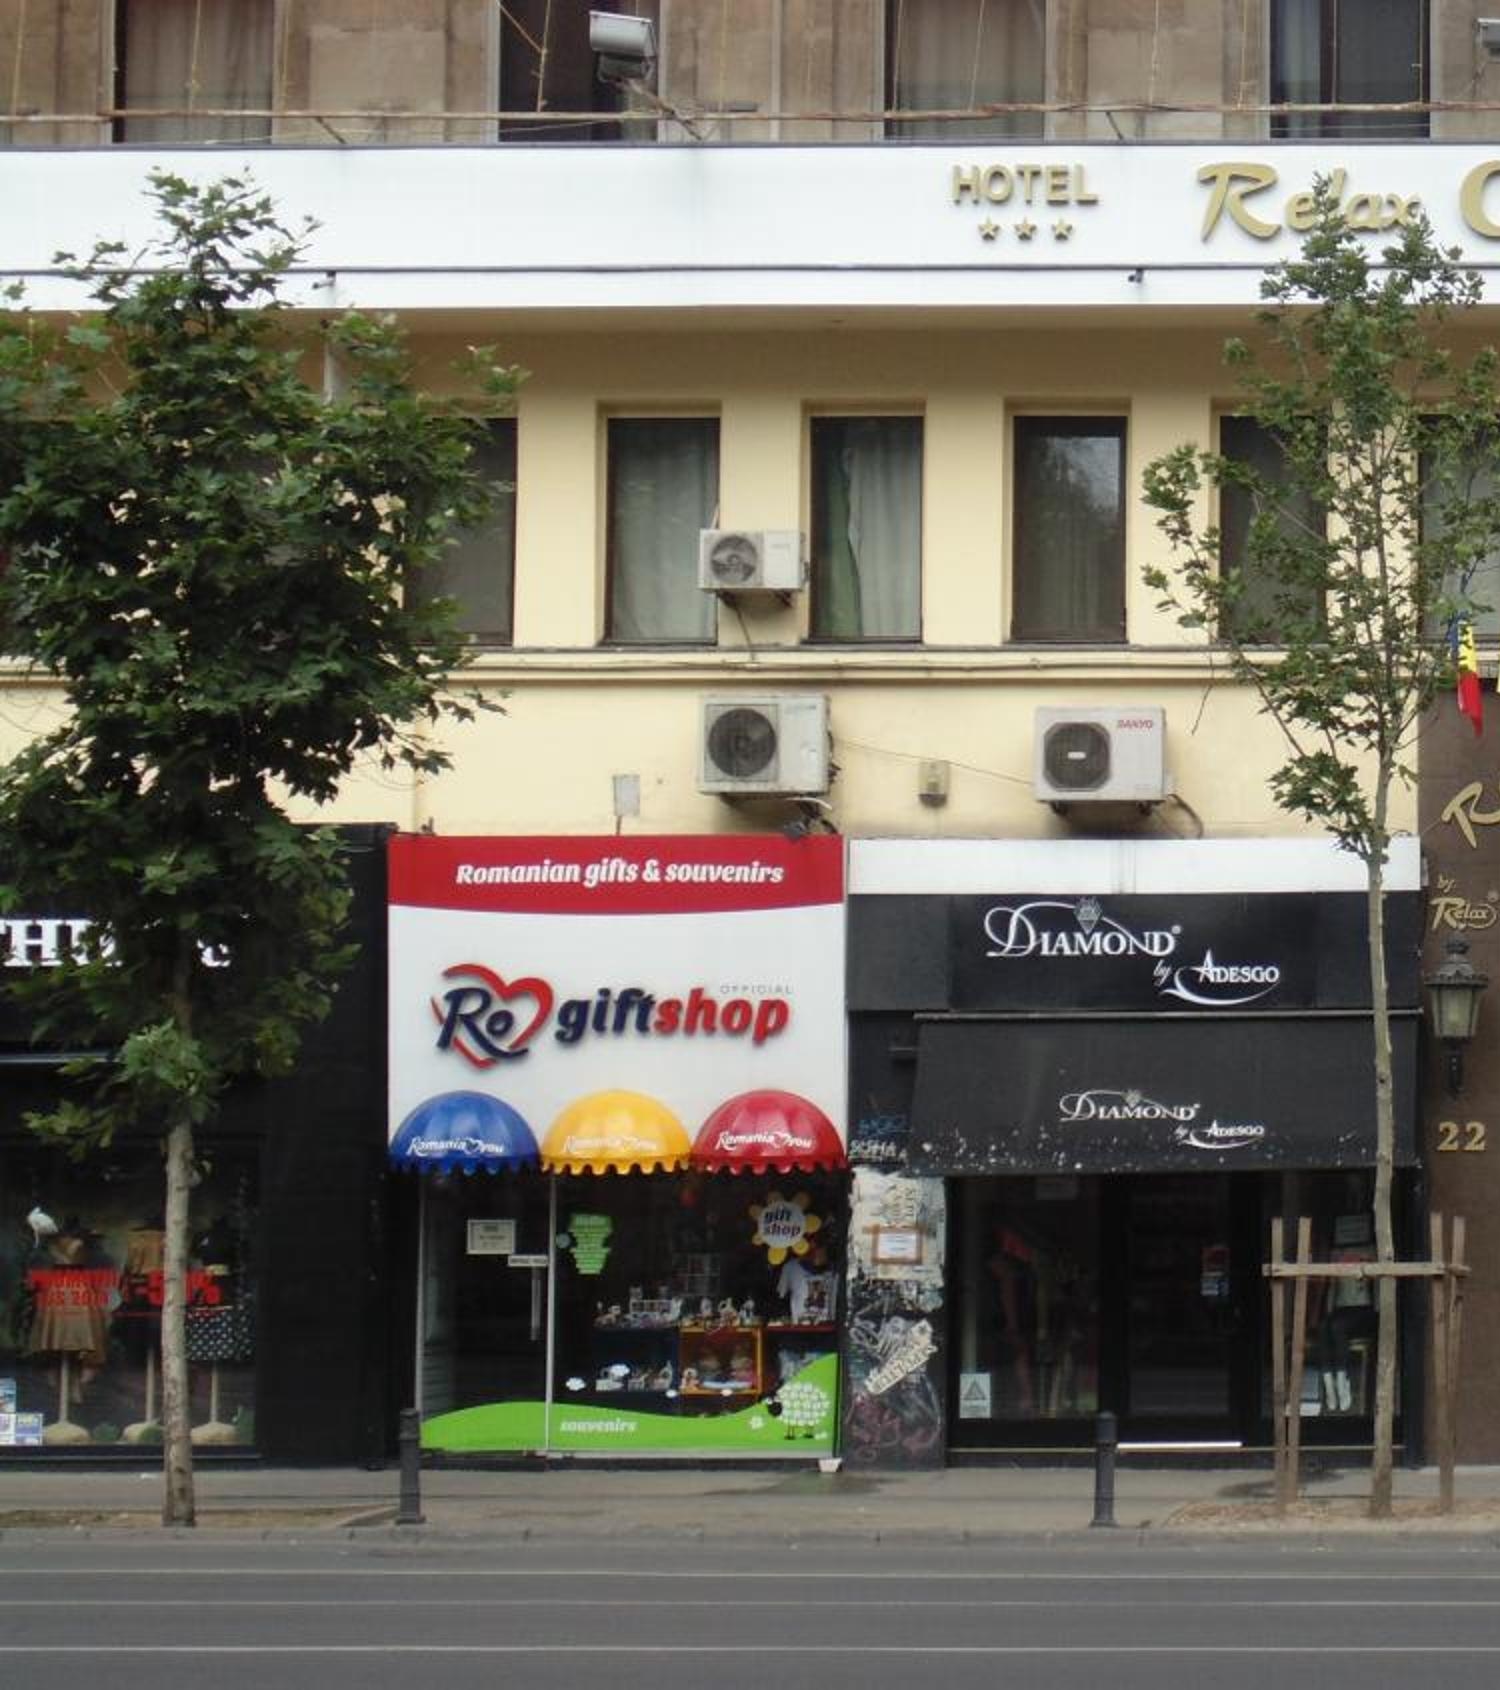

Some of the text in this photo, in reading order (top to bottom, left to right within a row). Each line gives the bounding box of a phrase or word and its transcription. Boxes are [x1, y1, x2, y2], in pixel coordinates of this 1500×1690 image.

[952, 164, 1099, 206] HOTEL
[1199, 161, 1422, 242] Relax
[1117, 719, 1153, 729] SANYO
[456, 858, 784, 888] Romanian gifts & souvenirs
[1437, 874, 1456, 893] by
[1430, 897, 1497, 930] Relax
[984, 901, 1177, 957] DIAMOND
[1153, 949, 1281, 985] by ADESGO
[719, 984, 794, 995] OFFICIAL
[435, 986, 530, 1060] Ro
[1059, 1090, 1199, 1121] DIAMOND
[716, 1131, 812, 1151] Romania you
[1174, 1119, 1266, 1139] by ADESGO
[1437, 1121, 1486, 1151] 22
[406, 1136, 505, 1157] Romania you
[764, 1206, 793, 1224] gift
[764, 1221, 802, 1239] shop
[560, 1418, 638, 1433] souvenirs
